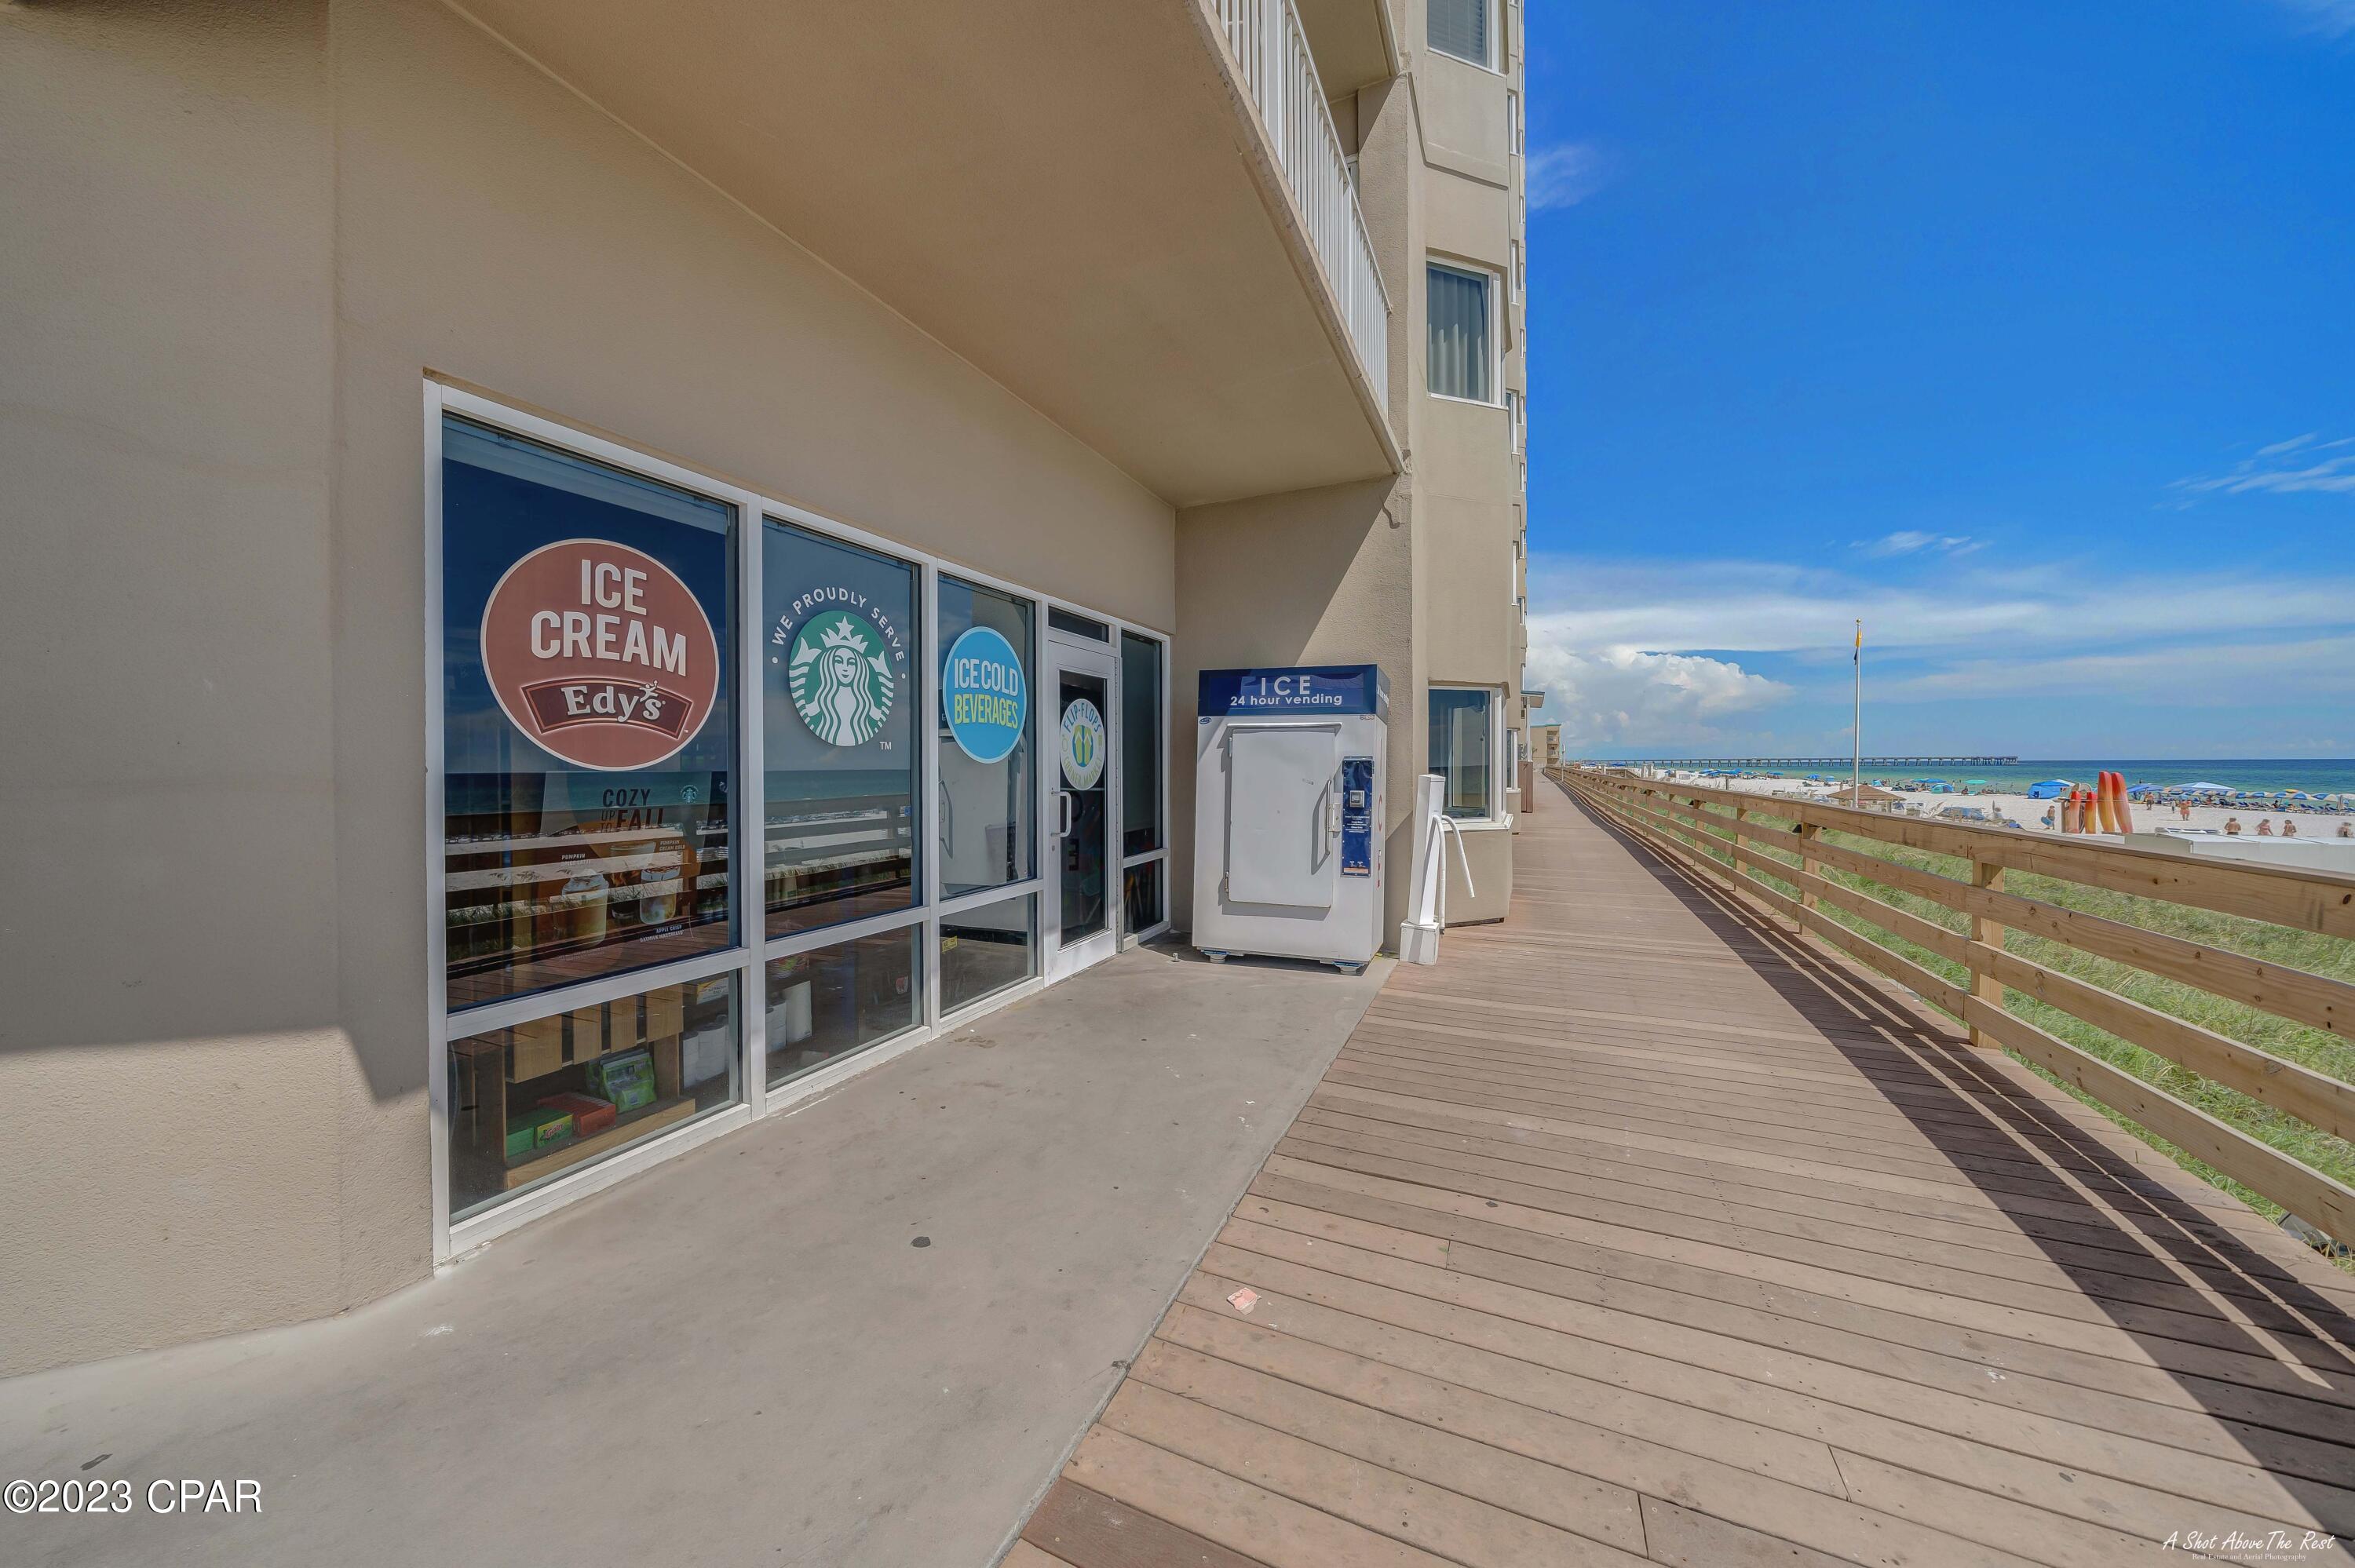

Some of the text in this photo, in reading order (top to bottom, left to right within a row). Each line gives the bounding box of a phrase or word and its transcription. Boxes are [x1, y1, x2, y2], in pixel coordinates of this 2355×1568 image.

[581, 559, 647, 615] ICE
[772, 587, 904, 662] WE PROUDLY SERVE
[531, 611, 686, 676] CREAM
[954, 658, 1018, 696] ICE COLD
[1261, 676, 1311, 695] ICE
[954, 694, 1018, 729] BEVERAGES
[1230, 693, 1342, 706] 24 hour vending
[879, 742, 892, 750] TM
[602, 788, 651, 808] COZY
[601, 809, 615, 822] UP
